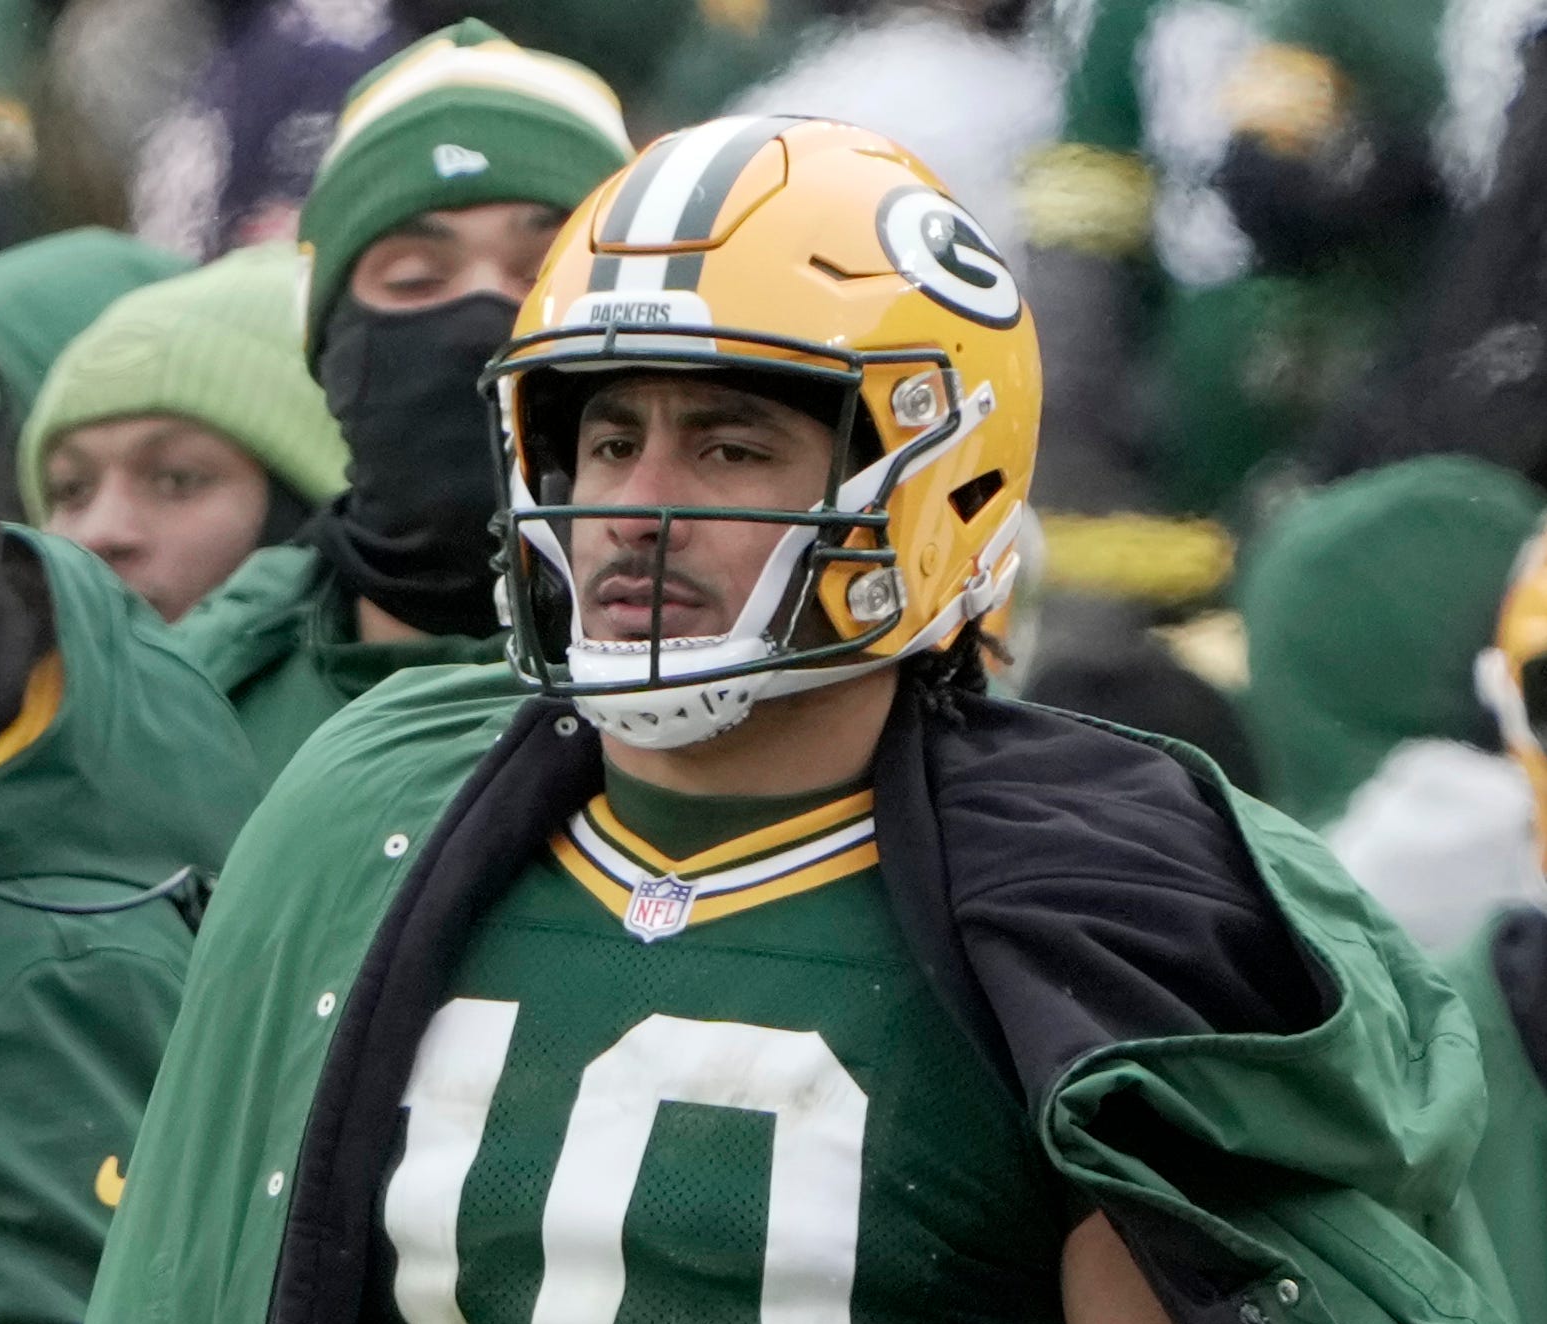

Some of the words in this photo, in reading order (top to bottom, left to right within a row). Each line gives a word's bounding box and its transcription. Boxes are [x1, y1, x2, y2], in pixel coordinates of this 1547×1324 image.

[886, 192, 1020, 319] G
[590, 301, 671, 323] PACKERS
[635, 898, 676, 928] NFL
